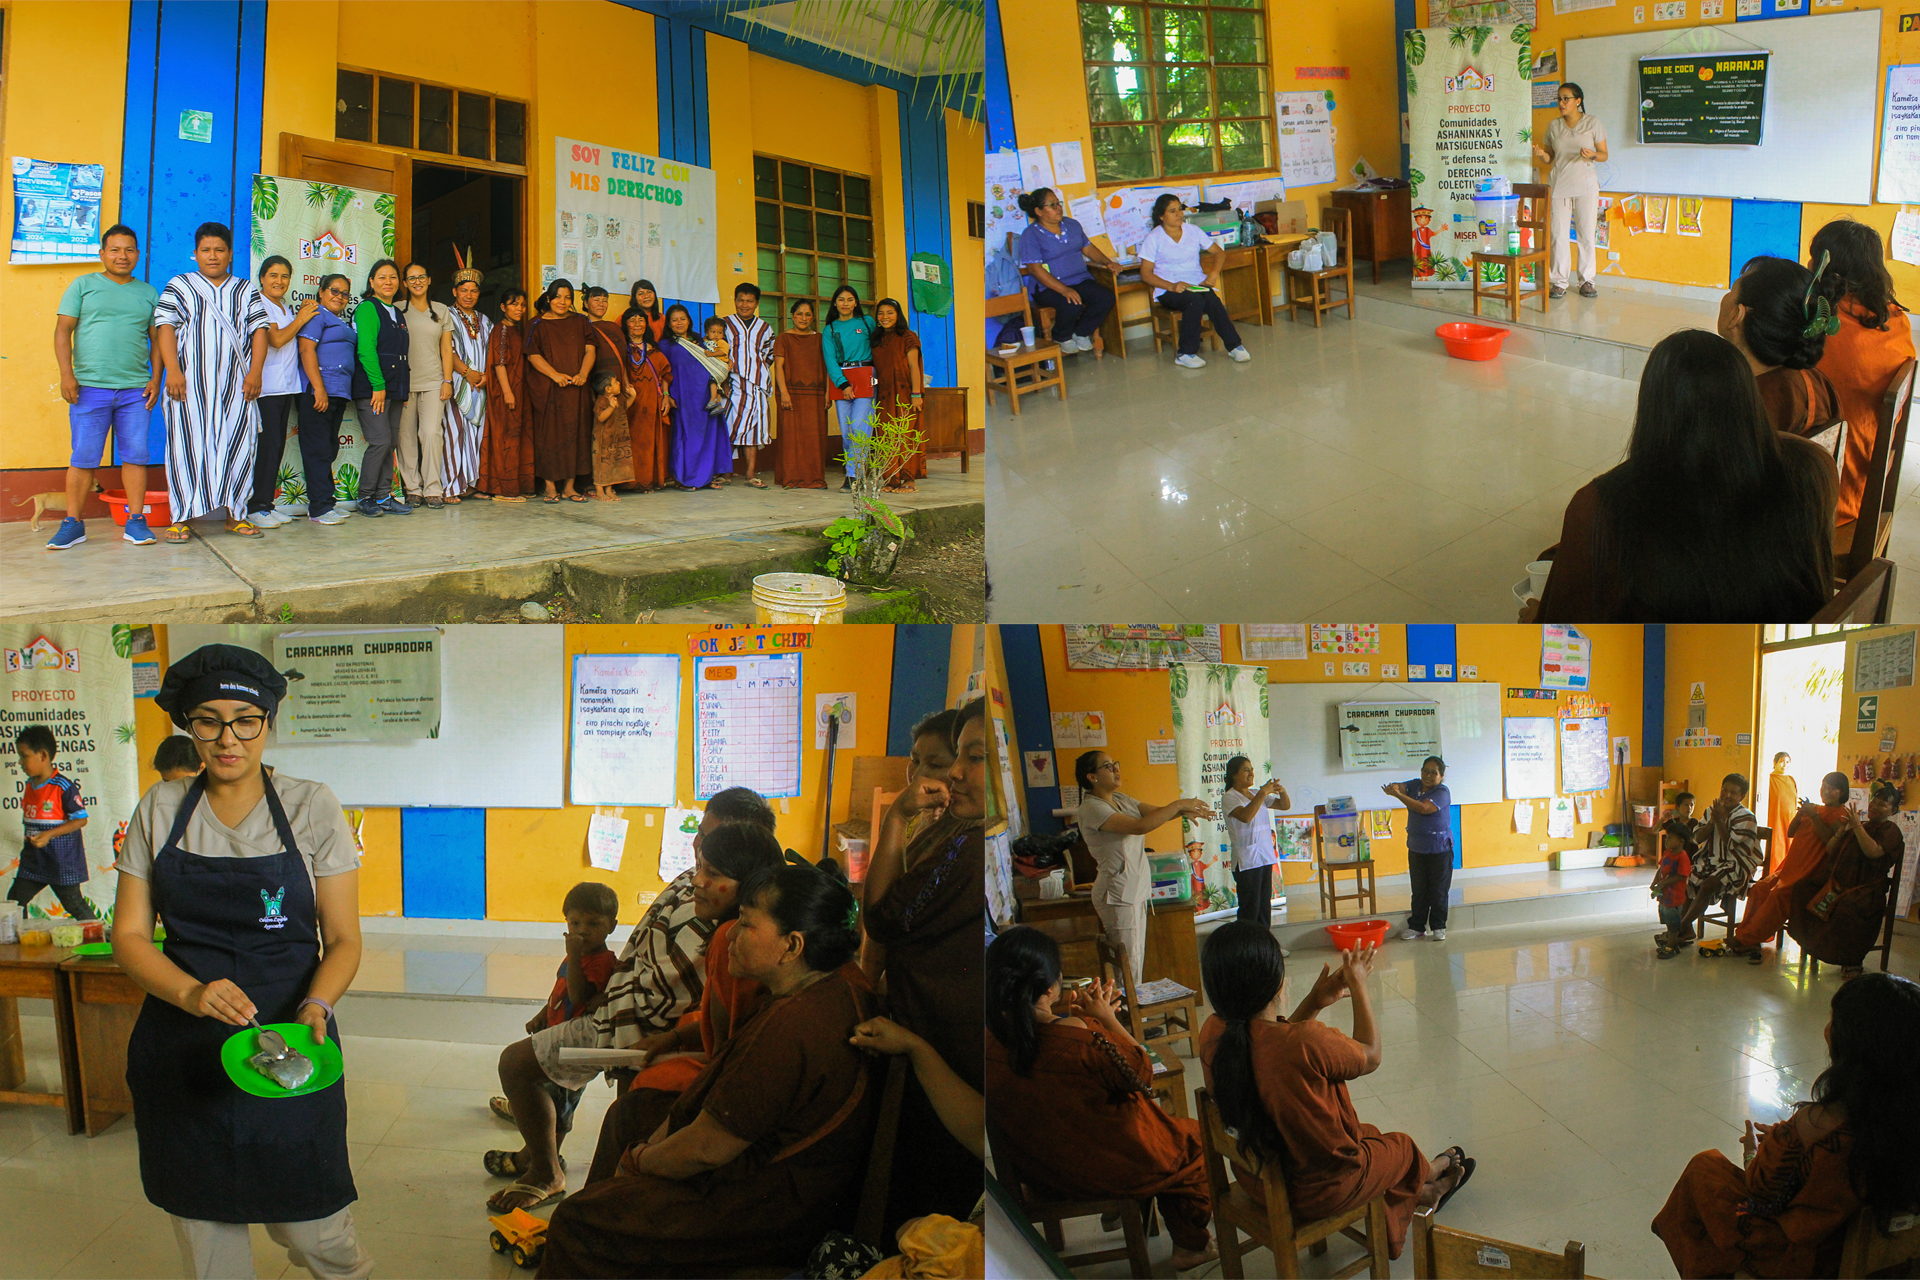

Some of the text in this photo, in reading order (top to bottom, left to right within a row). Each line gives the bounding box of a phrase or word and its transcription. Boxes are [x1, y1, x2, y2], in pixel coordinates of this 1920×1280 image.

[1643, 64, 1694, 75] AGUA DE COCO
[1716, 59, 1764, 72] NARANJA
[1448, 104, 1491, 114] PROYECTO
[1440, 117, 1497, 128] Comunidades
[1437, 128, 1501, 140] ASHANINKAS Y
[1435, 140, 1503, 151] MATSIGUENGAS
[572, 144, 690, 183] SOY FELIZ CON
[1452, 154, 1486, 164] defensa
[1448, 168, 1492, 178] DERECHOS
[570, 171, 683, 206] MIS DERECHOS
[71, 189, 80, 200] 3
[1450, 192, 1475, 202] Ayacu
[1651, 197, 1697, 223] 3 4
[1454, 231, 1477, 240] MISER
[1312, 632, 1353, 641] 3 8
[286, 641, 433, 658] CARACHAMA CHUPADORA
[1313, 643, 1354, 652] 4 9
[708, 668, 733, 678] MES
[580, 683, 607, 694] Kametsa
[789, 679, 797, 687] V
[12, 689, 76, 701] PROYECTO
[0, 708, 86, 722] Comunidades
[1346, 708, 1435, 719] CARACHAMA CHUPADORA
[83, 723, 91, 737] Y
[1858, 722, 1874, 730] SALIDA
[1210, 738, 1243, 747] PROYECTO
[82, 796, 97, 805] en
[25, 804, 37, 818] 25
